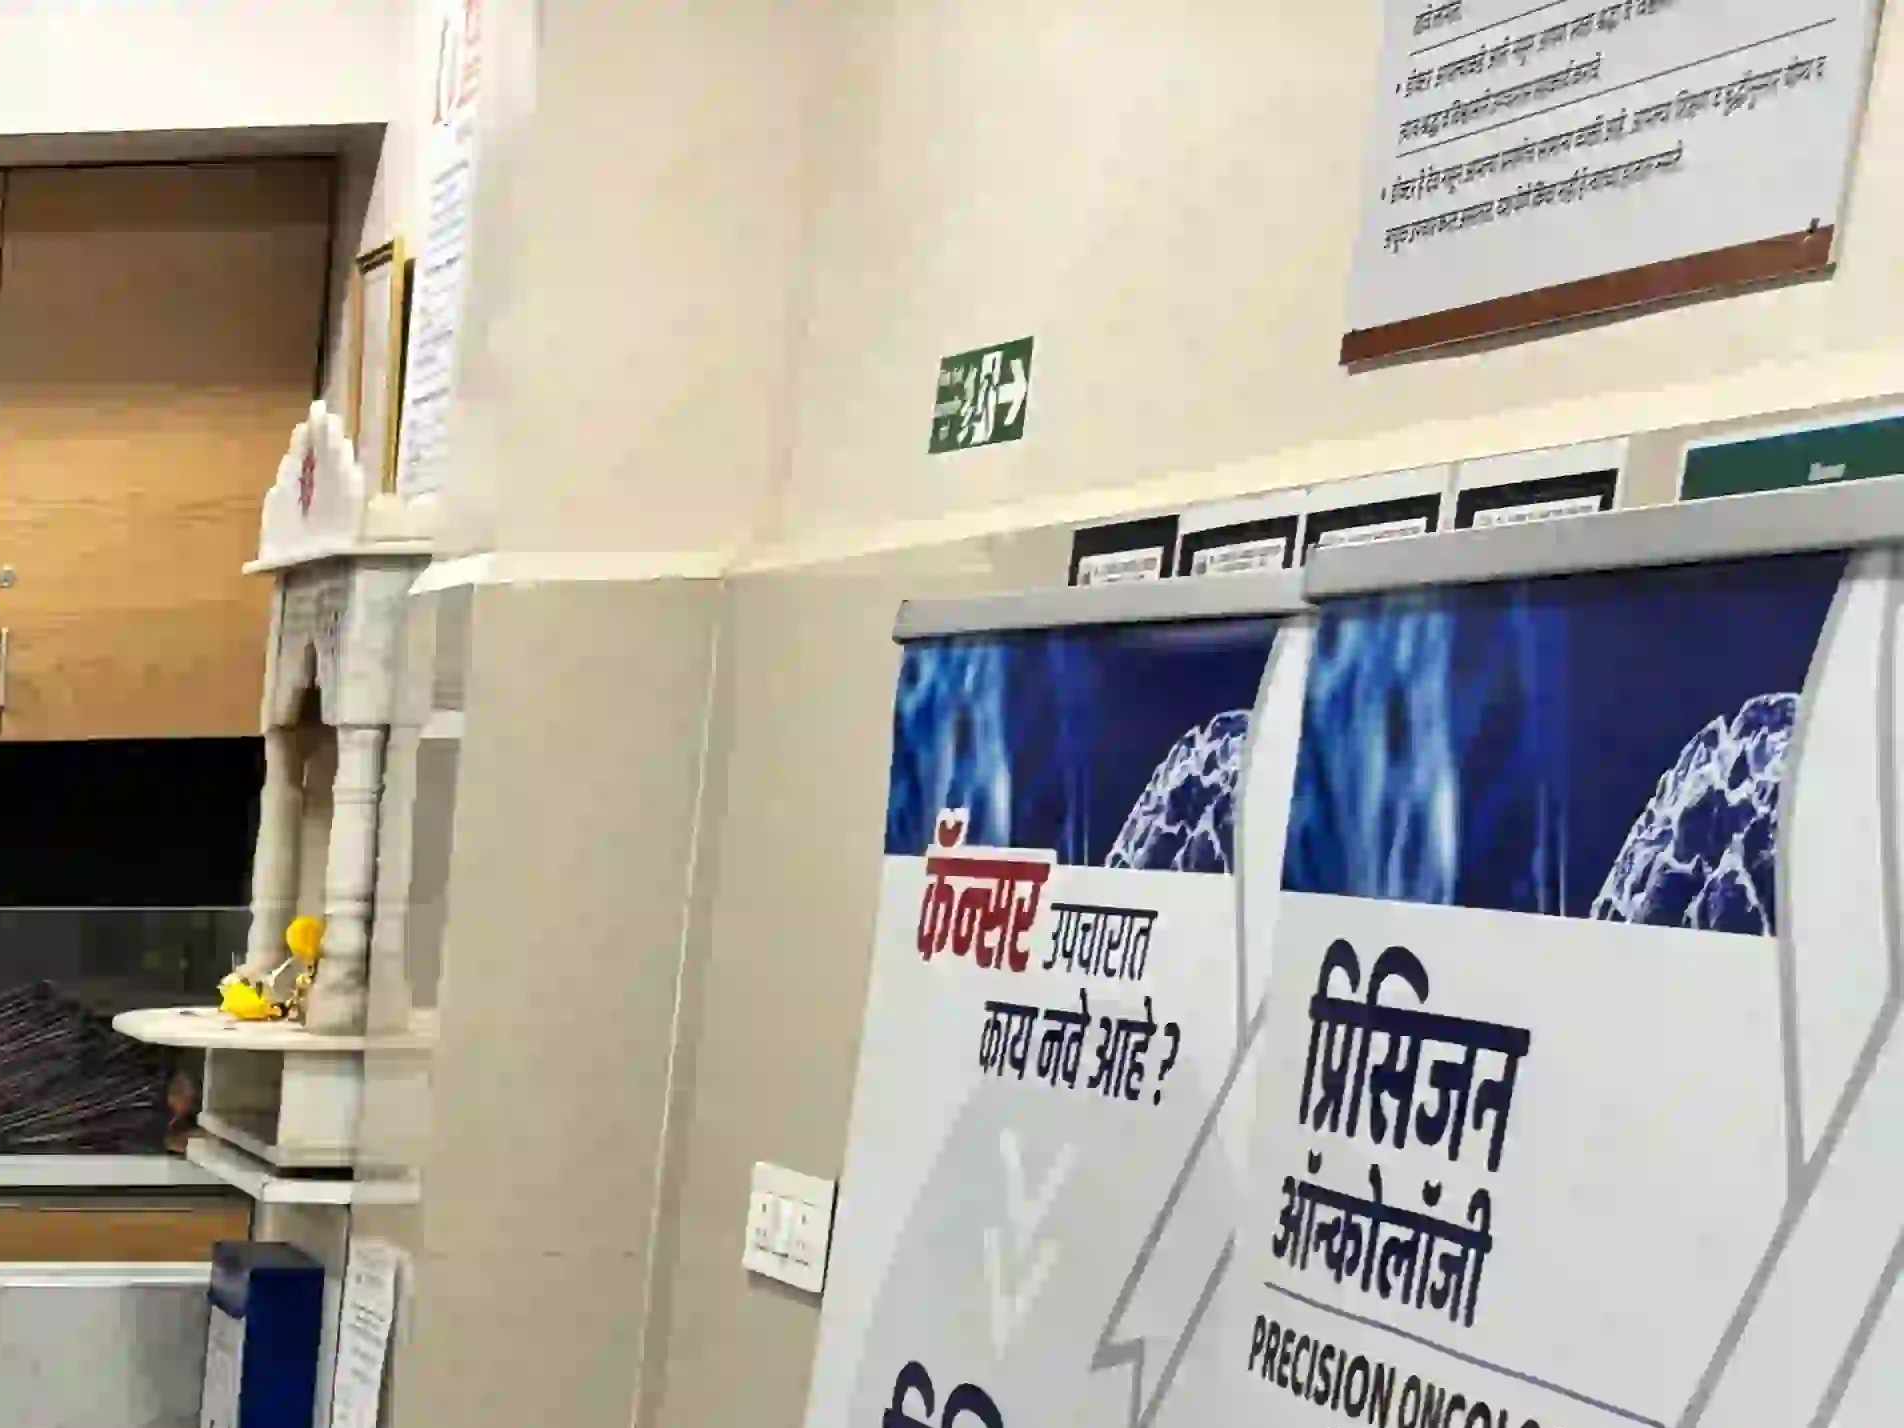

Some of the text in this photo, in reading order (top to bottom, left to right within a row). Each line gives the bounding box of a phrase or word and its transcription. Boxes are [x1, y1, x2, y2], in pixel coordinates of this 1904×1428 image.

[978, 1000, 1040, 1082] काय
[1036, 988, 1091, 1091] नवे
[1297, 937, 1532, 1173] प्रिसिजन
[1271, 1149, 1493, 1329] ऑन्कोलॉजी
